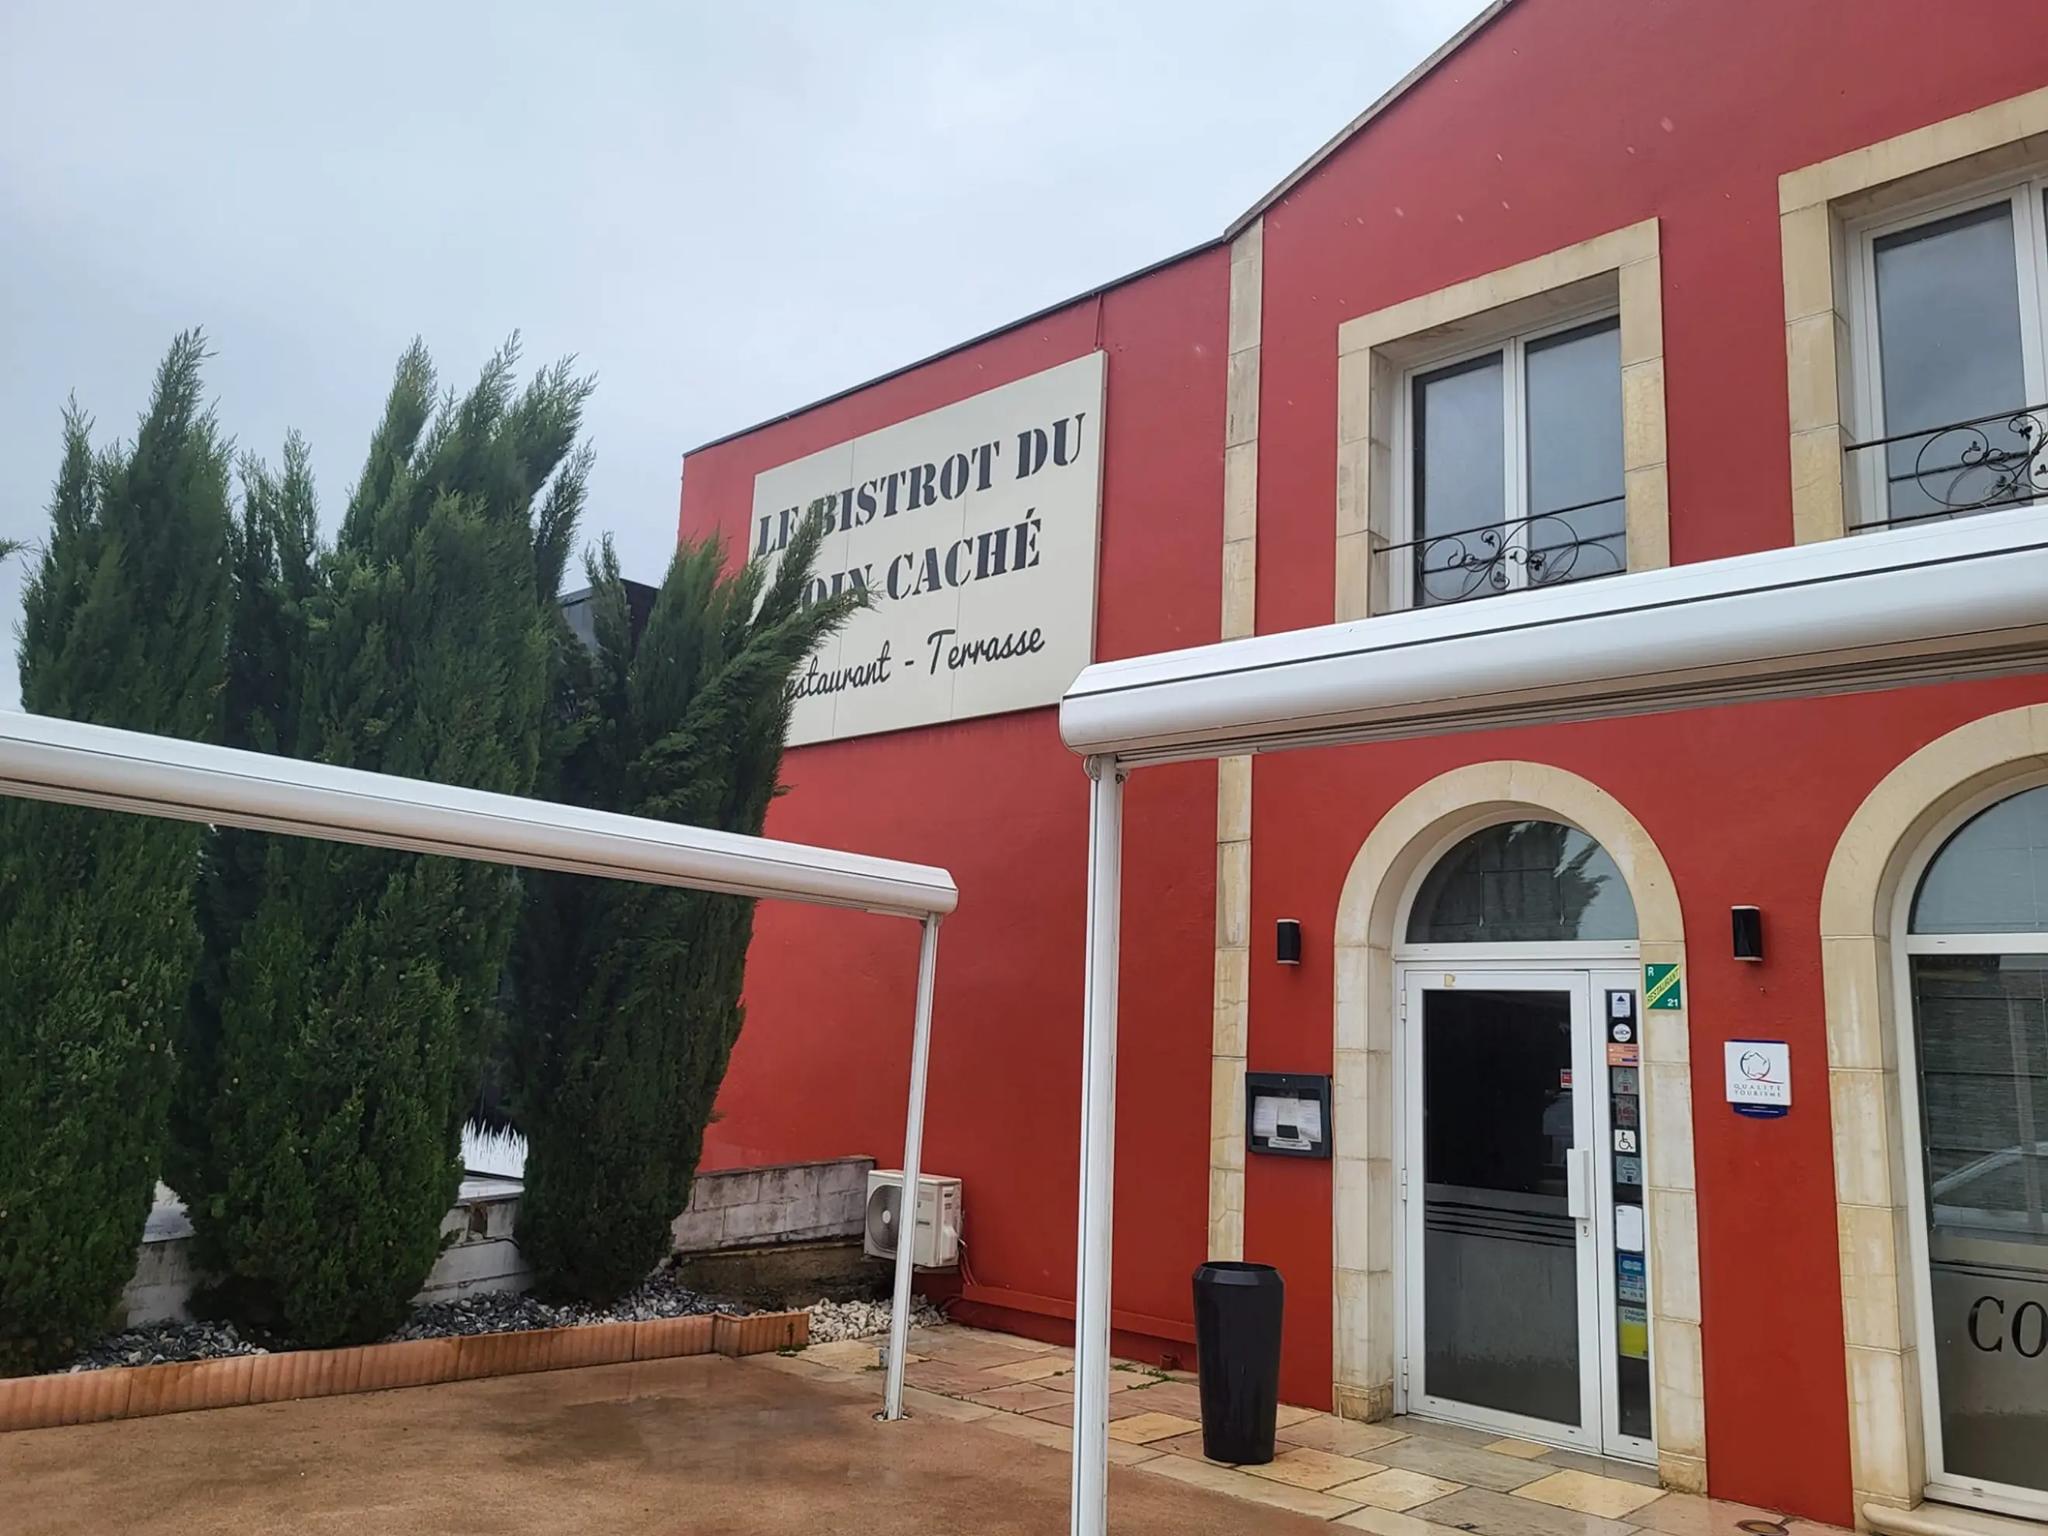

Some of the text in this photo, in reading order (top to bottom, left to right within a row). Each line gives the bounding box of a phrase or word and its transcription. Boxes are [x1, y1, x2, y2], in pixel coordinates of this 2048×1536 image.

[757, 412, 1086, 557] LE BISTROT DU
[886, 507, 1042, 601] CACHÉ
[784, 627, 1045, 700] estaurant - Terrasse
[1647, 966, 1655, 977] R
[1667, 998, 1679, 1007] 21
